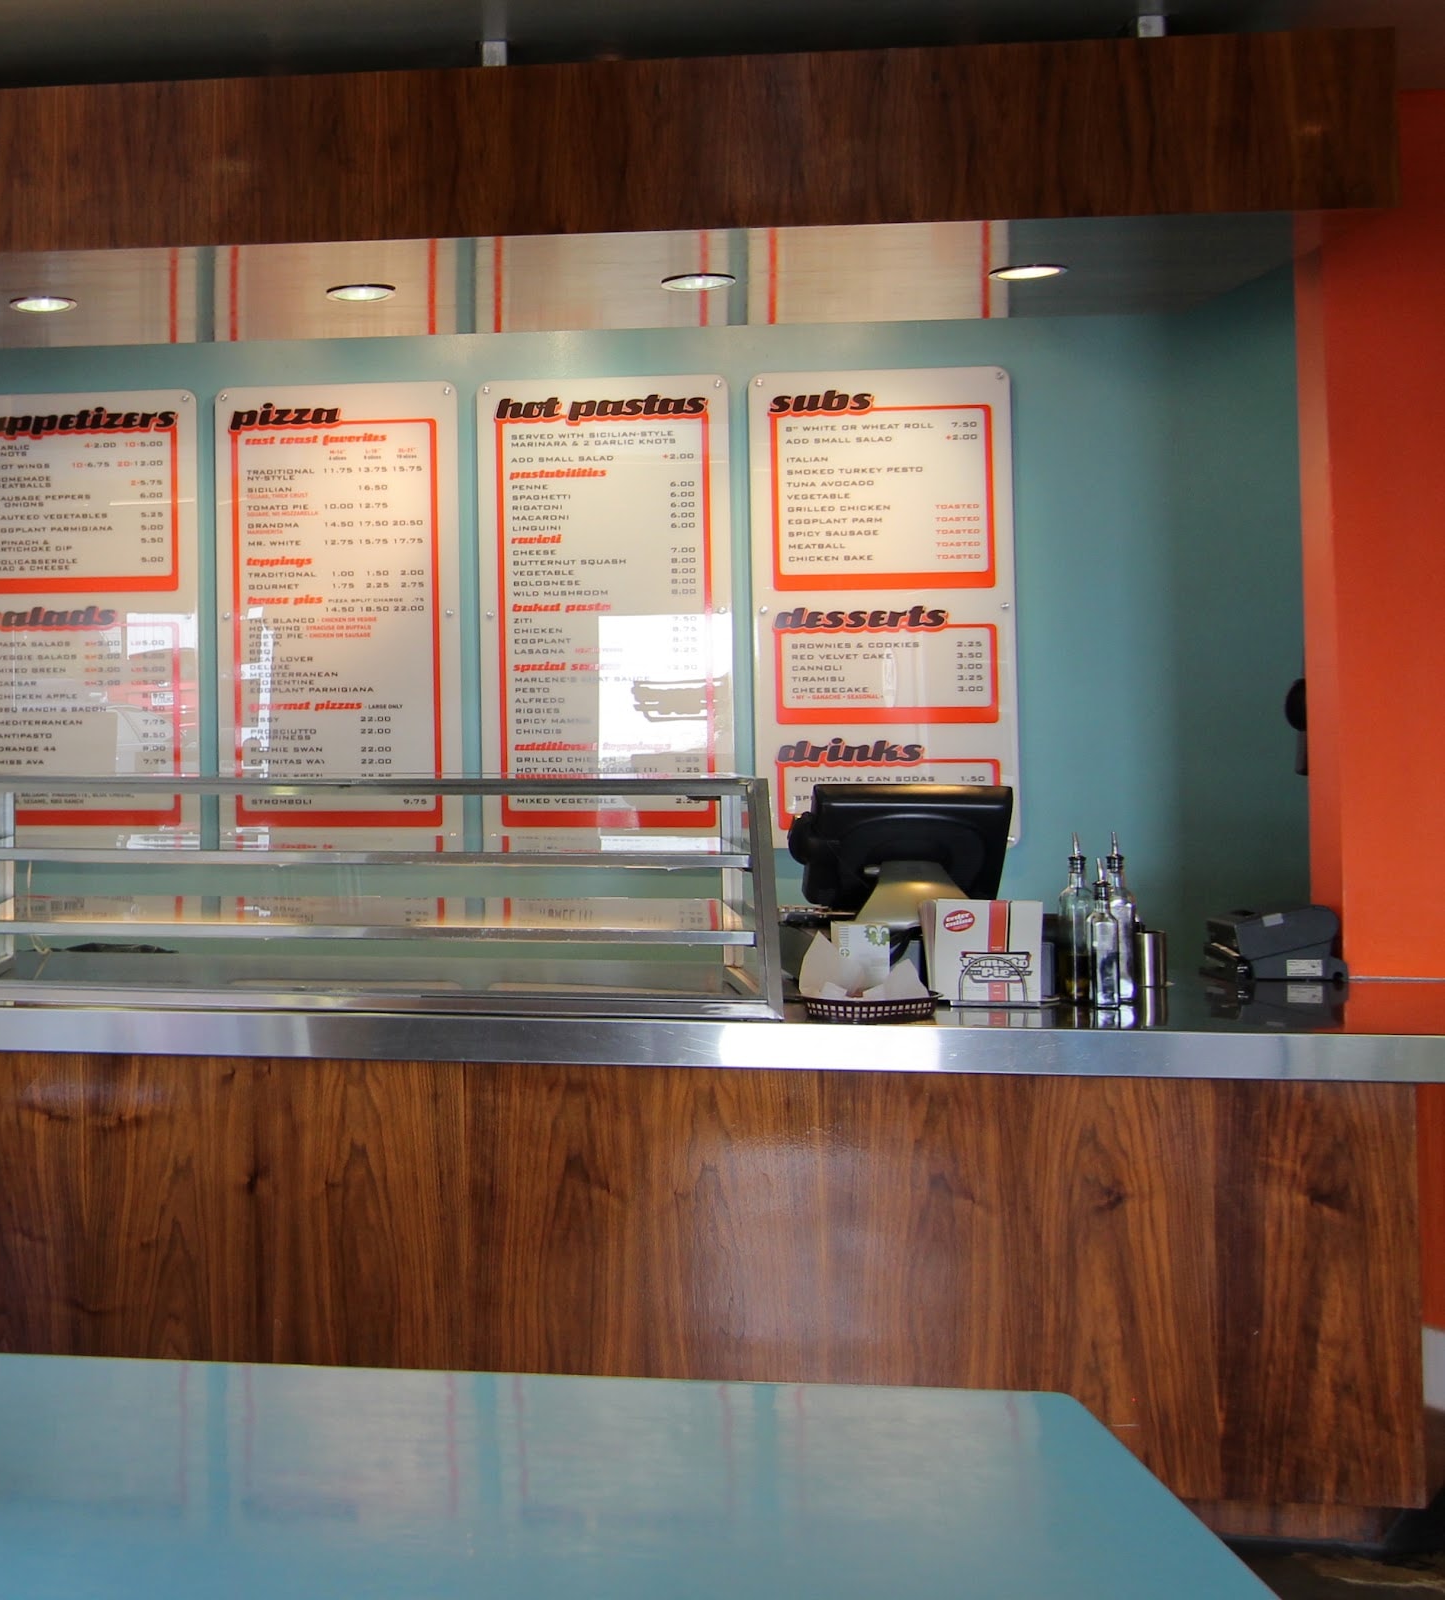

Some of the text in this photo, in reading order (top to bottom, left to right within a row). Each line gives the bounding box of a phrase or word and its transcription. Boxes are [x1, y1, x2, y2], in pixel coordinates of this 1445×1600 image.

[769, 390, 874, 415] subs
[495, 395, 707, 423] hot pastas
[229, 403, 340, 431] pizza
[245, 433, 387, 446] east coast favorites
[510, 468, 607, 480] pastabilities
[511, 534, 561, 544] ravioli
[247, 556, 312, 567] toppings
[293, 595, 323, 605] pies
[774, 606, 947, 632] desserts
[513, 661, 566, 672] special
[315, 701, 362, 711] pizzas
[777, 738, 924, 765] drinks
[981, 967, 1010, 977] Pie
